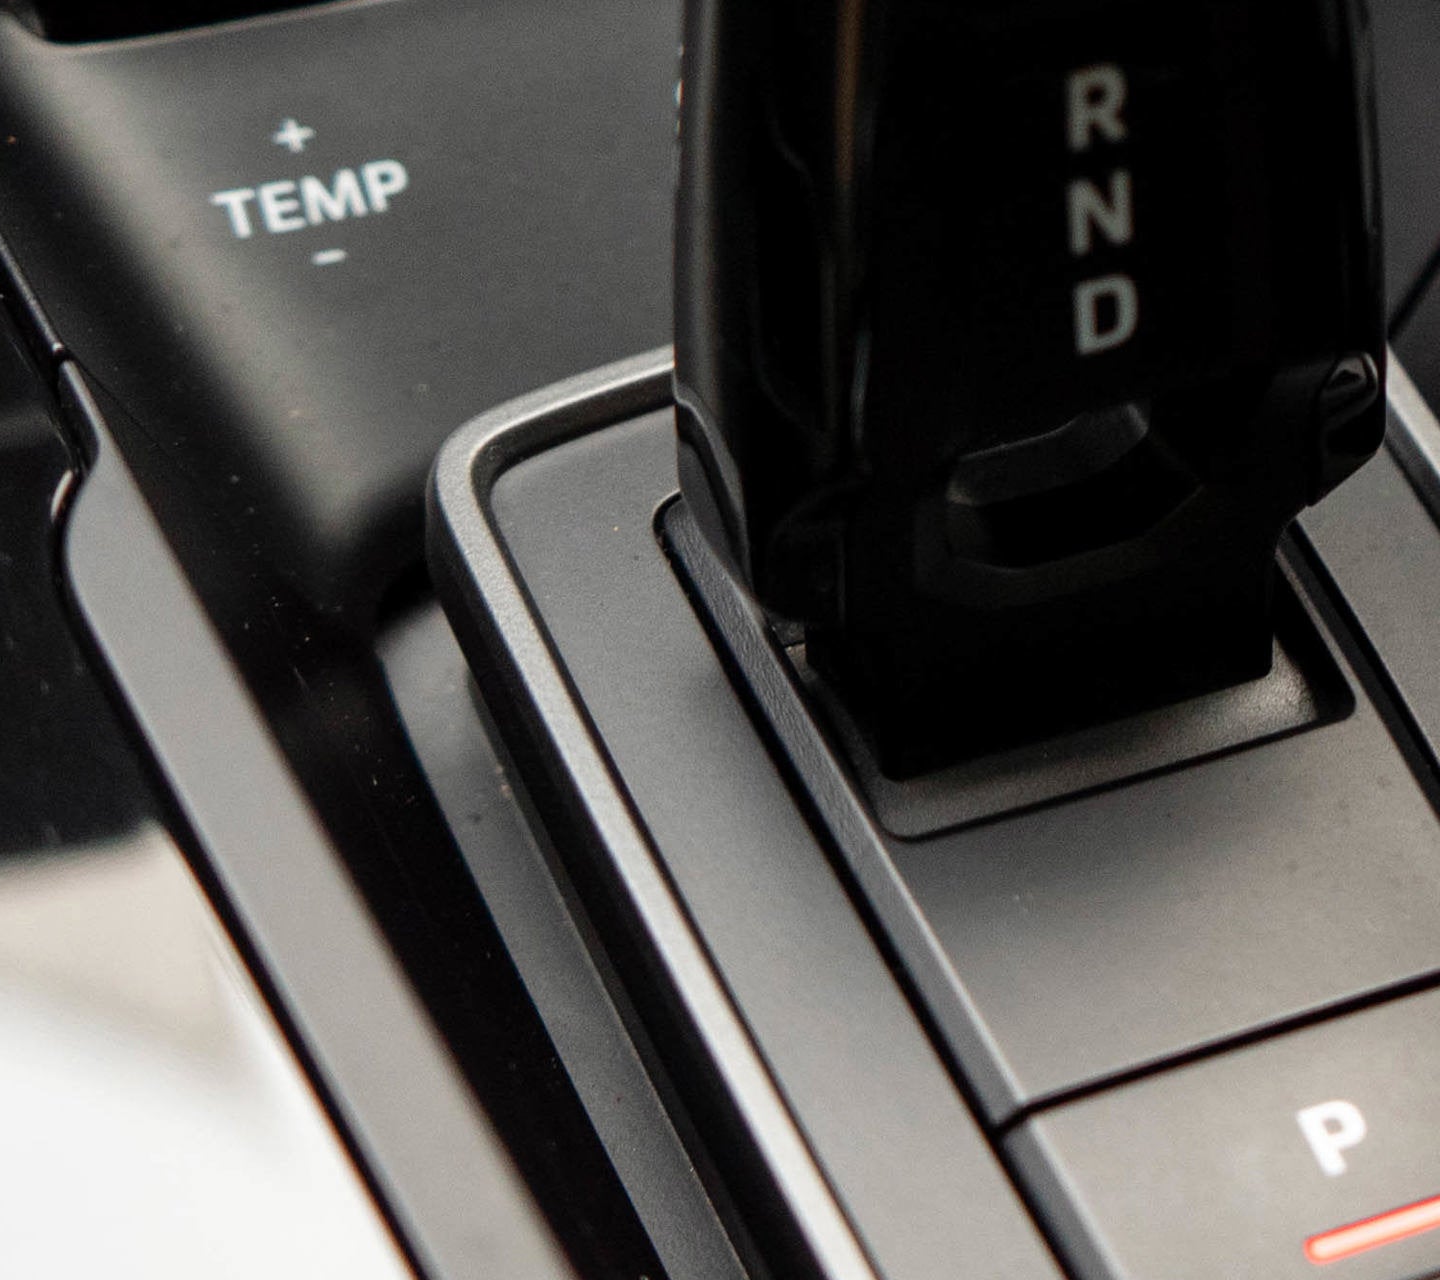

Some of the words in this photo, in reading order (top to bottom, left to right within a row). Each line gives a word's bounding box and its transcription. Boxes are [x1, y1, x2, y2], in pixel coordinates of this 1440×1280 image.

[1064, 62, 1129, 152] R
[209, 158, 410, 239] TEMP
[1066, 168, 1135, 256] N
[1071, 272, 1141, 357] D
[1295, 1099, 1368, 1177] P
